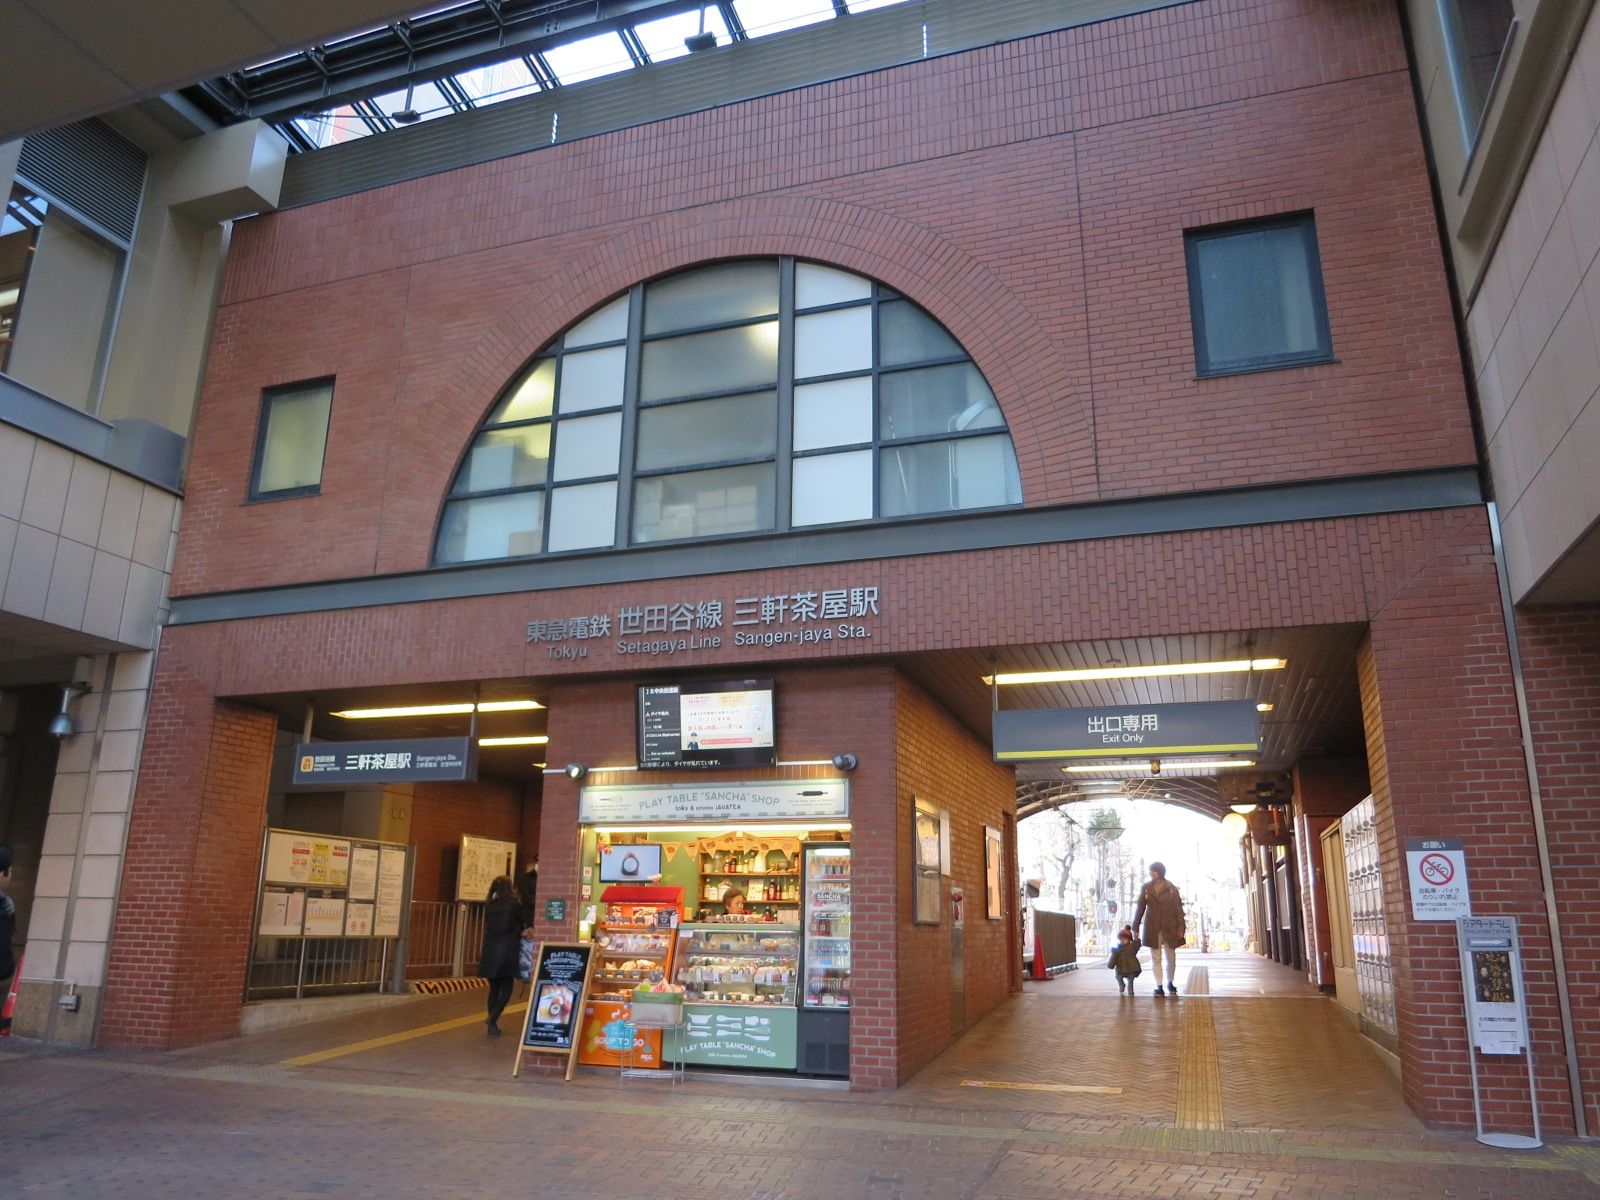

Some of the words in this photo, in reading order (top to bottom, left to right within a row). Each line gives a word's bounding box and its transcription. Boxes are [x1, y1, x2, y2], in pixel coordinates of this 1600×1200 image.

[527, 614, 611, 642] 東急電鉄
[618, 600, 723, 636] 世田谷線
[732, 586, 879, 626] 三軒茶屋駅
[546, 646, 588, 660] Tokyu
[617, 638, 686, 655] Setagaya
[690, 634, 721, 649] Line
[734, 627, 833, 647] Sangen-jaya
[837, 624, 872, 639] Sta.
[1087, 714, 1158, 733] 出口専用
[1102, 734, 1120, 743] Exit
[1122, 733, 1143, 744] Only
[345, 752, 412, 770] 三軒茶屋駅
[639, 797, 664, 810] PLAY
[667, 792, 698, 805] TABLE
[701, 791, 750, 802] "SANCHA"
[752, 794, 781, 807] SHOP
[594, 1037, 615, 1045] SOUP
[699, 1040, 722, 1049] TABLE
